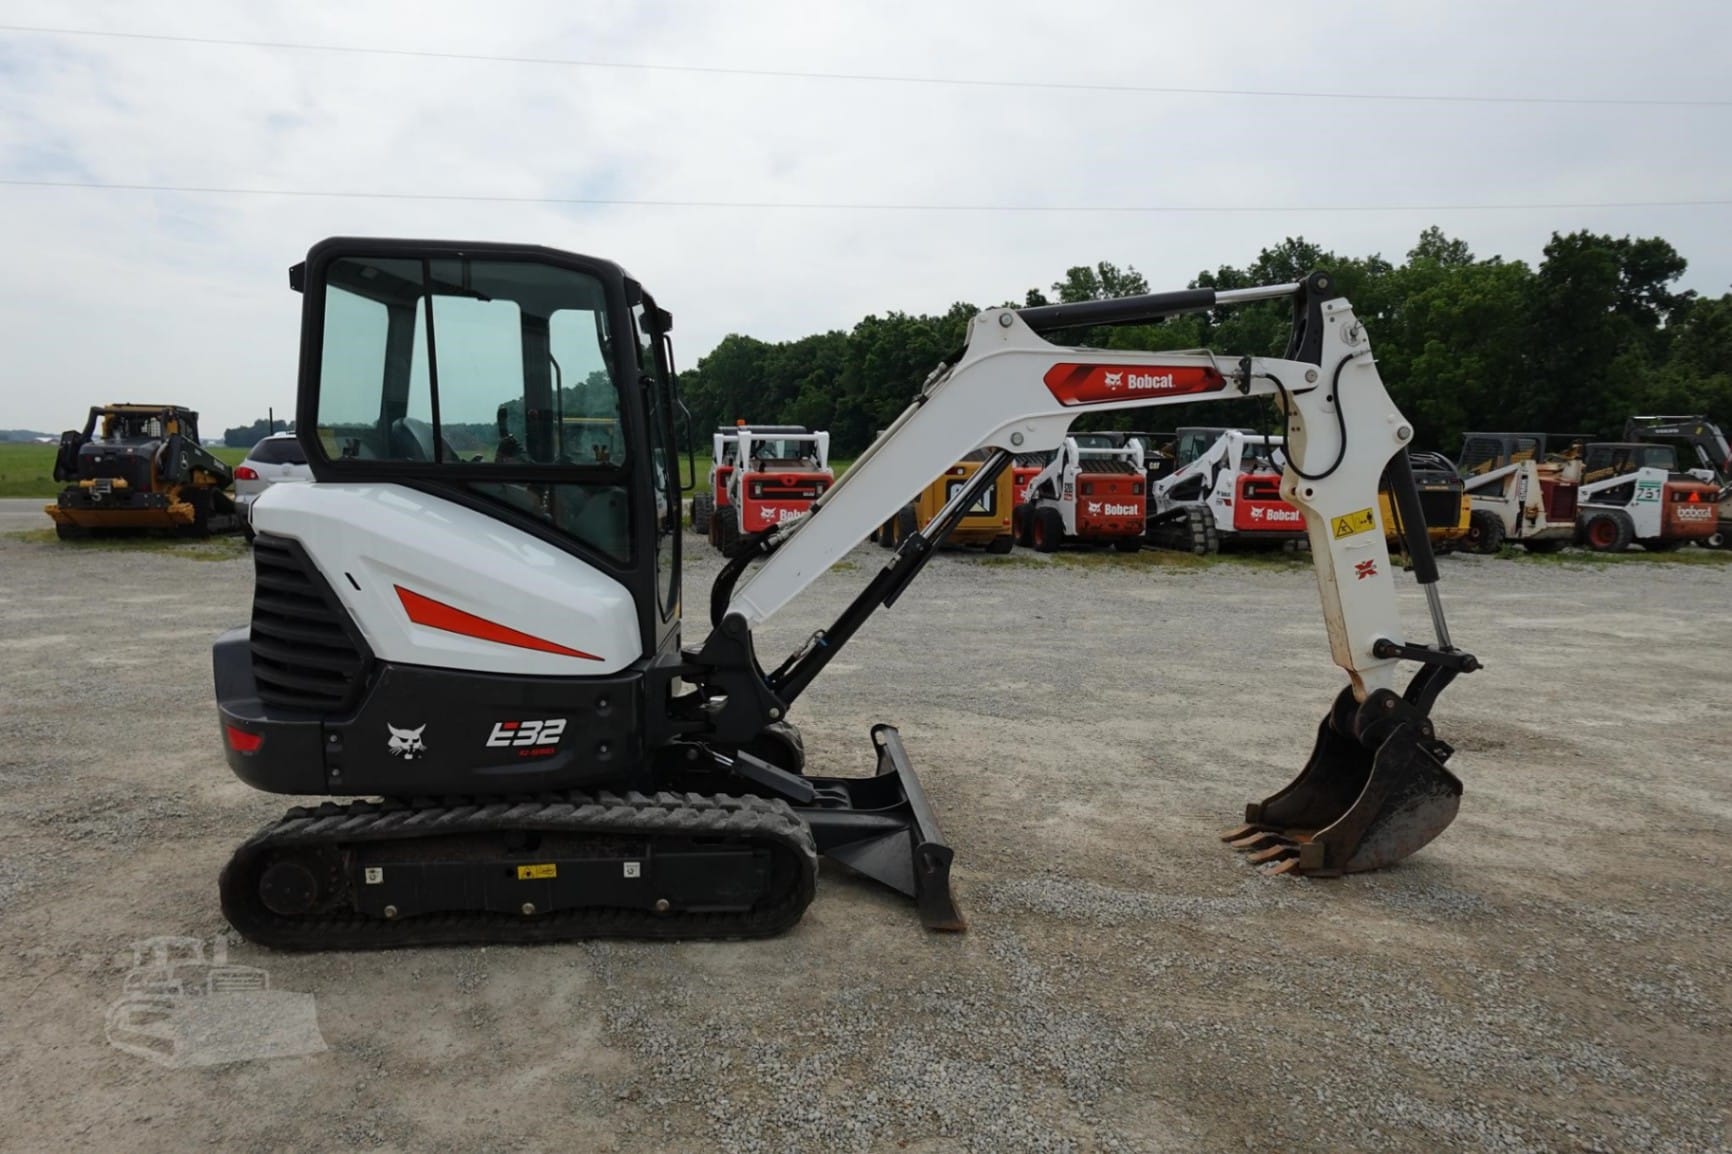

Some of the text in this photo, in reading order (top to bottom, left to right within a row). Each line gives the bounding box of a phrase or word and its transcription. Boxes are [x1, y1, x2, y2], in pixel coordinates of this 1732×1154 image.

[1127, 373, 1174, 390] Bobcat
[1104, 503, 1138, 516] Bobcat
[1266, 508, 1300, 521] Bobcat
[485, 717, 567, 747] E32
